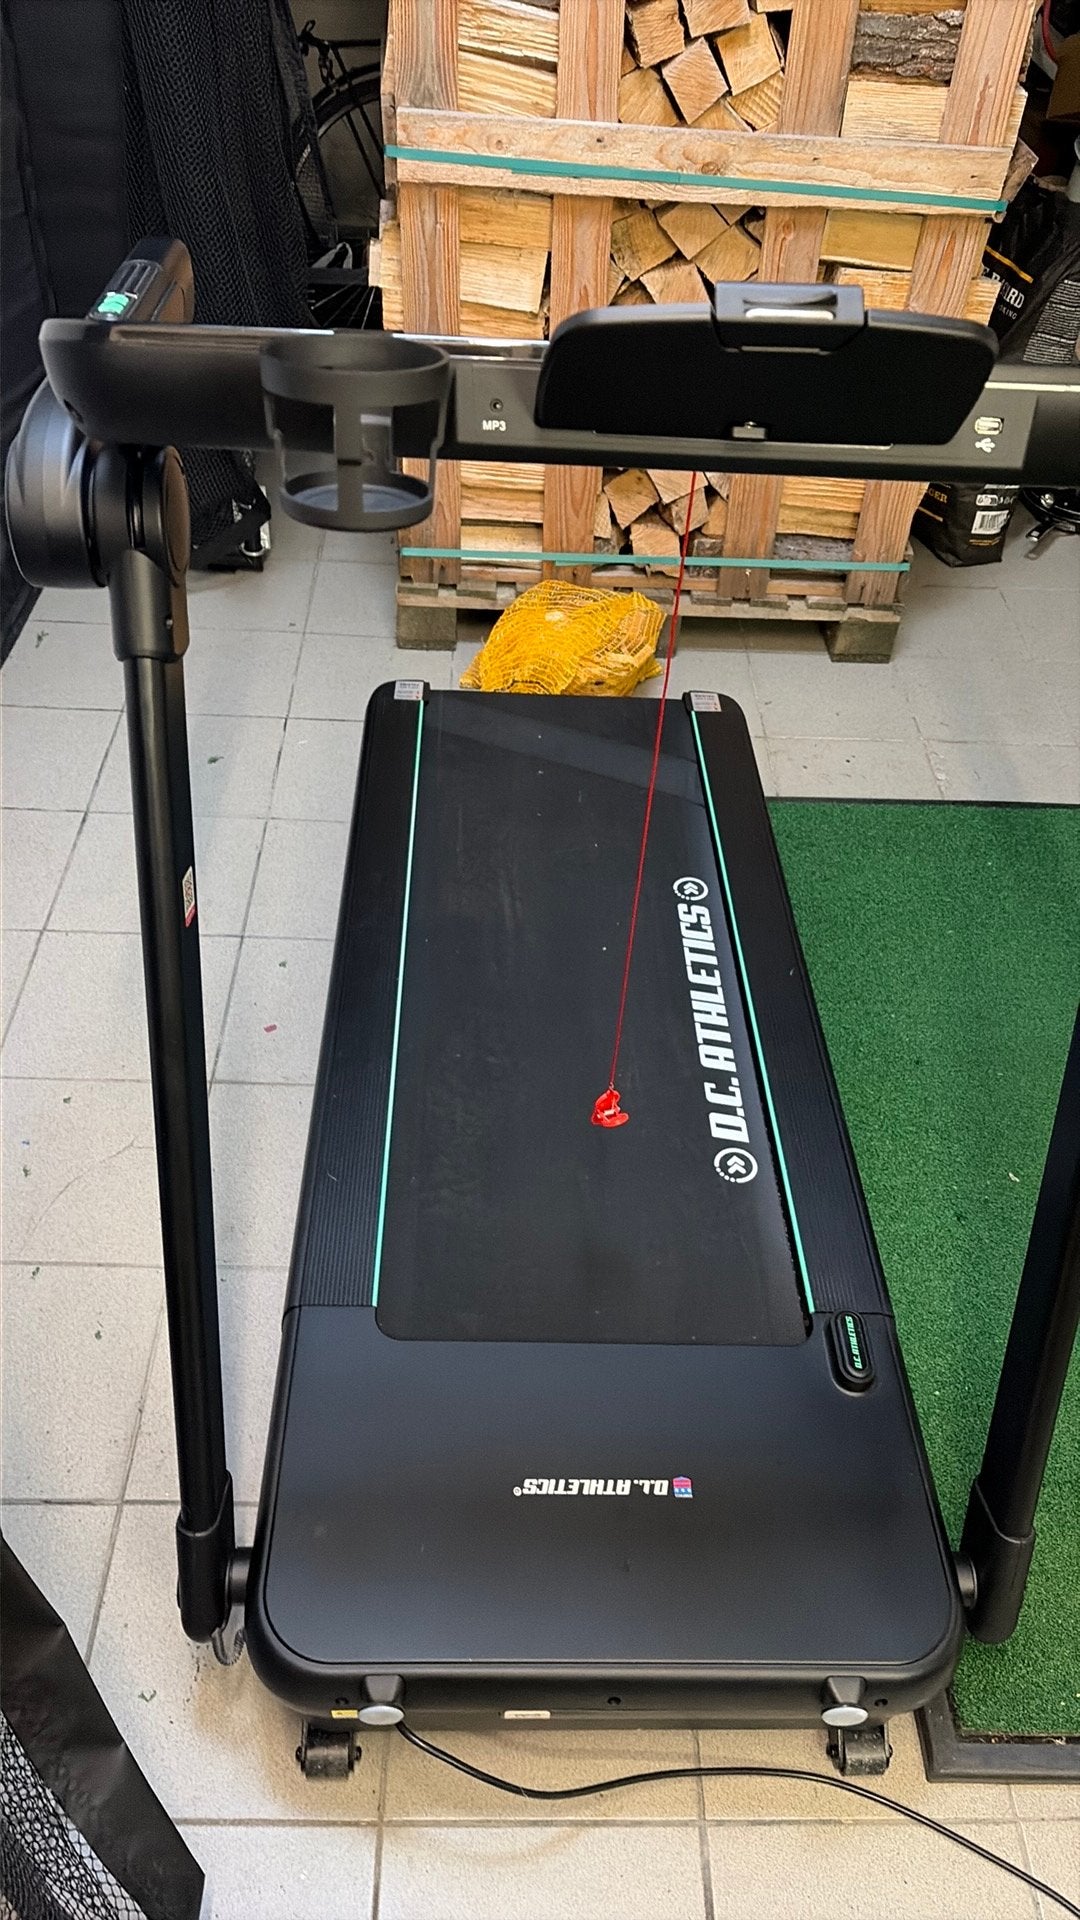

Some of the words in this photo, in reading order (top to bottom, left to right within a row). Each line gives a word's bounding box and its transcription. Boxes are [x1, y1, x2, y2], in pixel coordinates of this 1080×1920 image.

[482, 419, 507, 432] MP3
[677, 903, 737, 1073] ATHLETICS
[703, 1076, 750, 1144] D.C.
[845, 1315, 860, 1355] ATHLETICS
